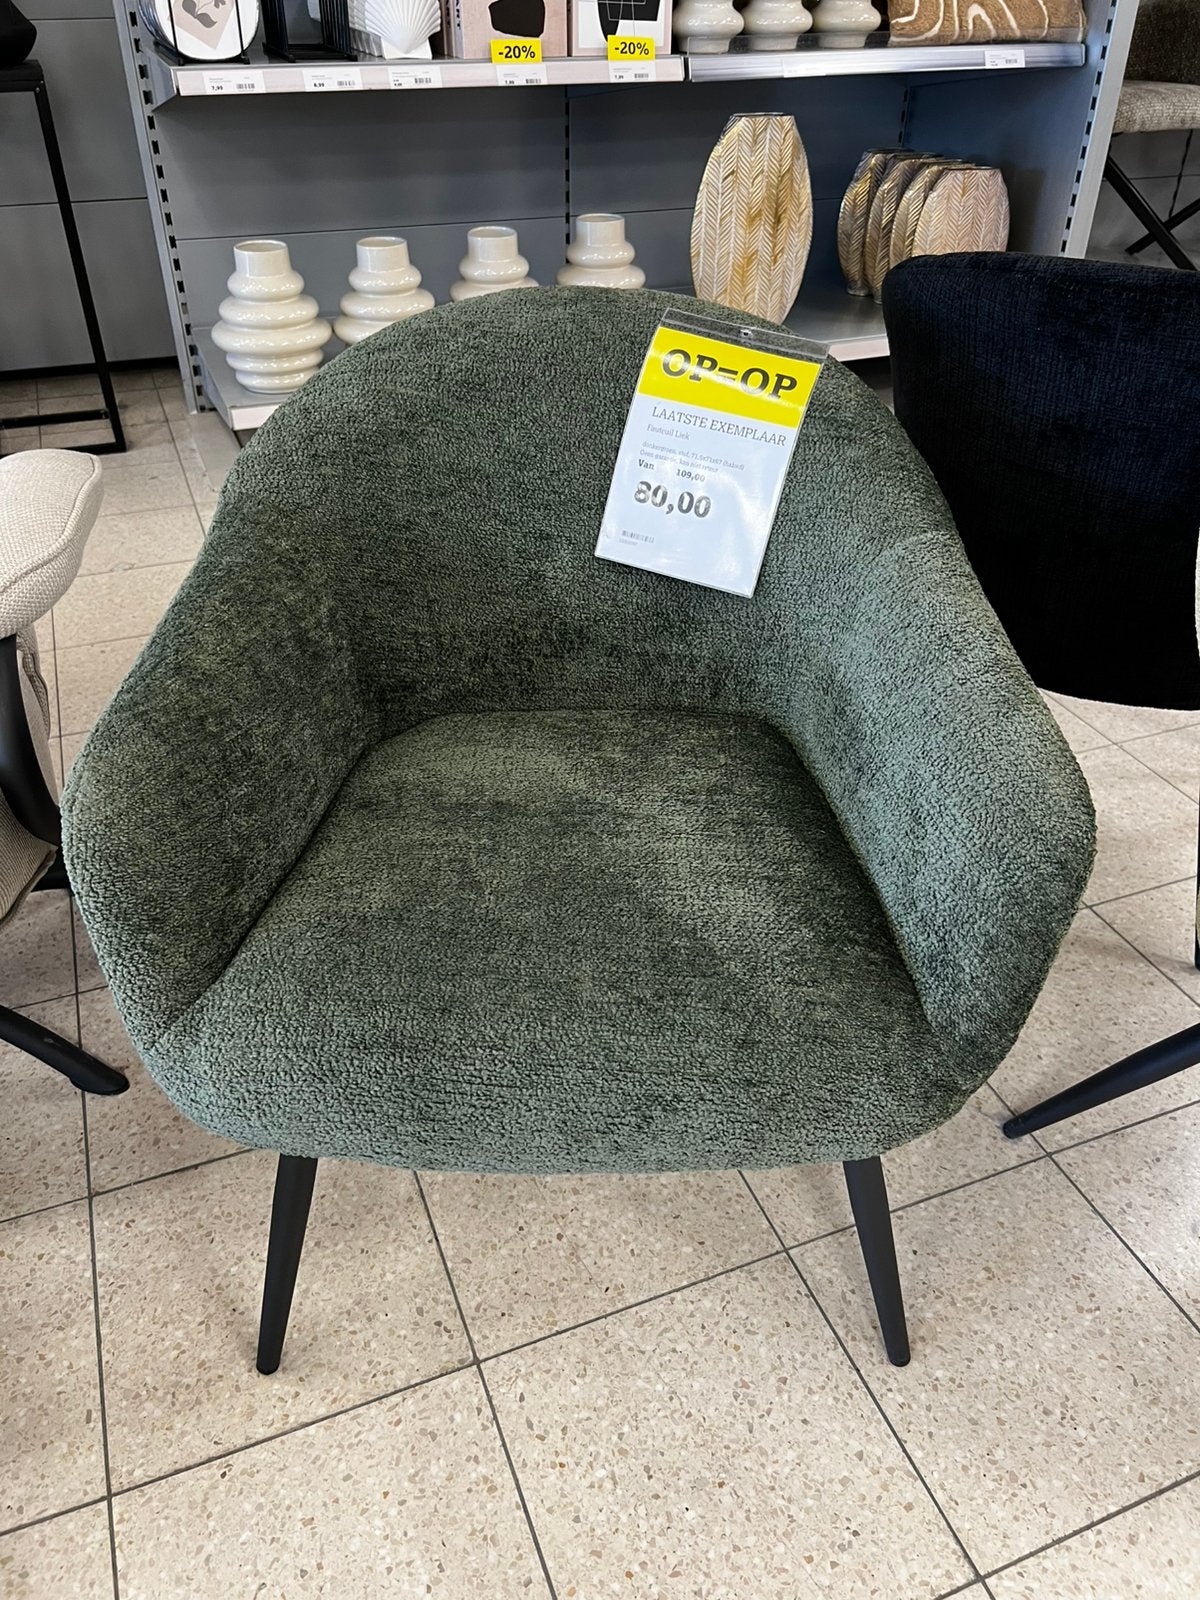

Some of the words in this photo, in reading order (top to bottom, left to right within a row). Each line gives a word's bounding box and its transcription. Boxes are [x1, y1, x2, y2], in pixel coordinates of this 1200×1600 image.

[498, 45, 536, 59] -20%
[614, 41, 650, 56] -20%
[662, 348, 798, 399] OP=OP
[646, 423, 674, 438] Fauteuil
[675, 429, 690, 441] Liek
[651, 406, 709, 429] LAATSTE
[709, 419, 787, 446] EXEMPLAAR
[638, 459, 655, 471] Van
[676, 468, 706, 483] 109,00
[634, 480, 712, 519] 80,00
